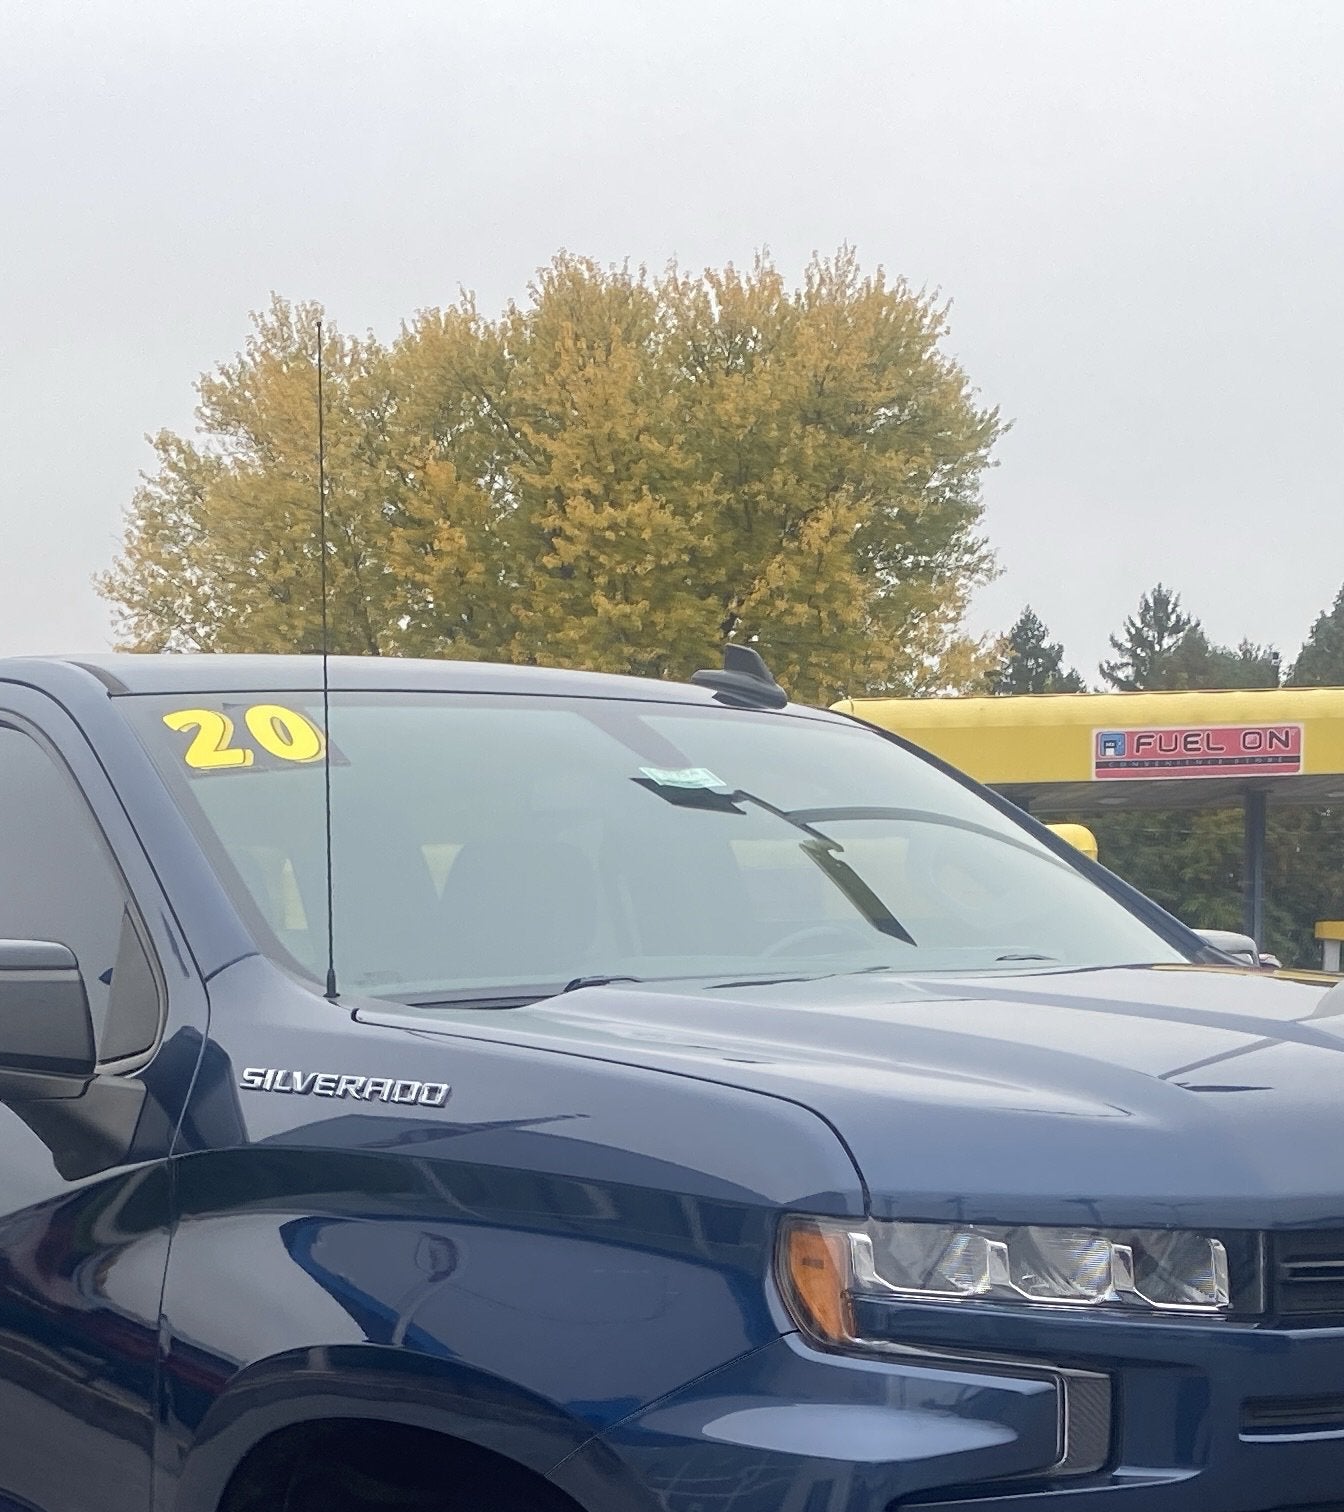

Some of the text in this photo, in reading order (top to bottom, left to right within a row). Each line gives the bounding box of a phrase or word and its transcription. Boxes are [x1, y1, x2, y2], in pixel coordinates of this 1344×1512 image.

[162, 704, 327, 770] 20
[1134, 729, 1292, 754] FUEL ON
[239, 1067, 452, 1108] SILVERADO
